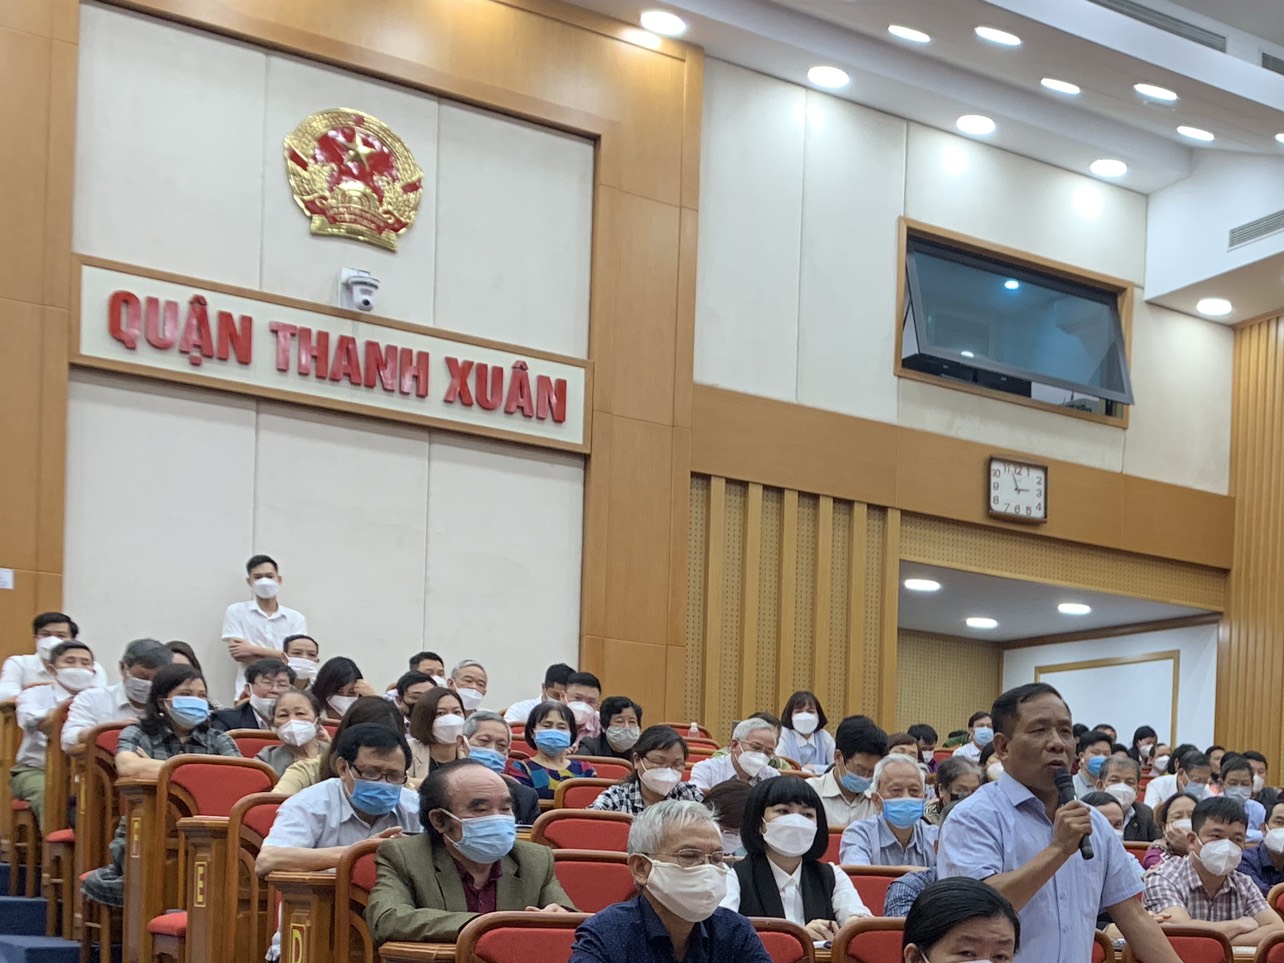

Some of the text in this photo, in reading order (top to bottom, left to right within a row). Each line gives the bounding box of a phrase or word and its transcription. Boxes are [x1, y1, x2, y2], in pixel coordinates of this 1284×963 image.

[107, 289, 568, 424] QUẬN THANH XUÂN
[991, 468, 1001, 478] 10
[1003, 463, 1010, 474] 11
[1014, 464, 1023, 476] 12
[1036, 476, 1042, 485] 2
[993, 481, 999, 491] 9
[1036, 488, 1042, 498] 3
[993, 495, 999, 505] 8
[1004, 502, 1011, 513] 7
[1014, 504, 1021, 514] 6
[1026, 506, 1032, 516] 5
[1035, 502, 1041, 511] 4
[197, 866, 204, 902] E
